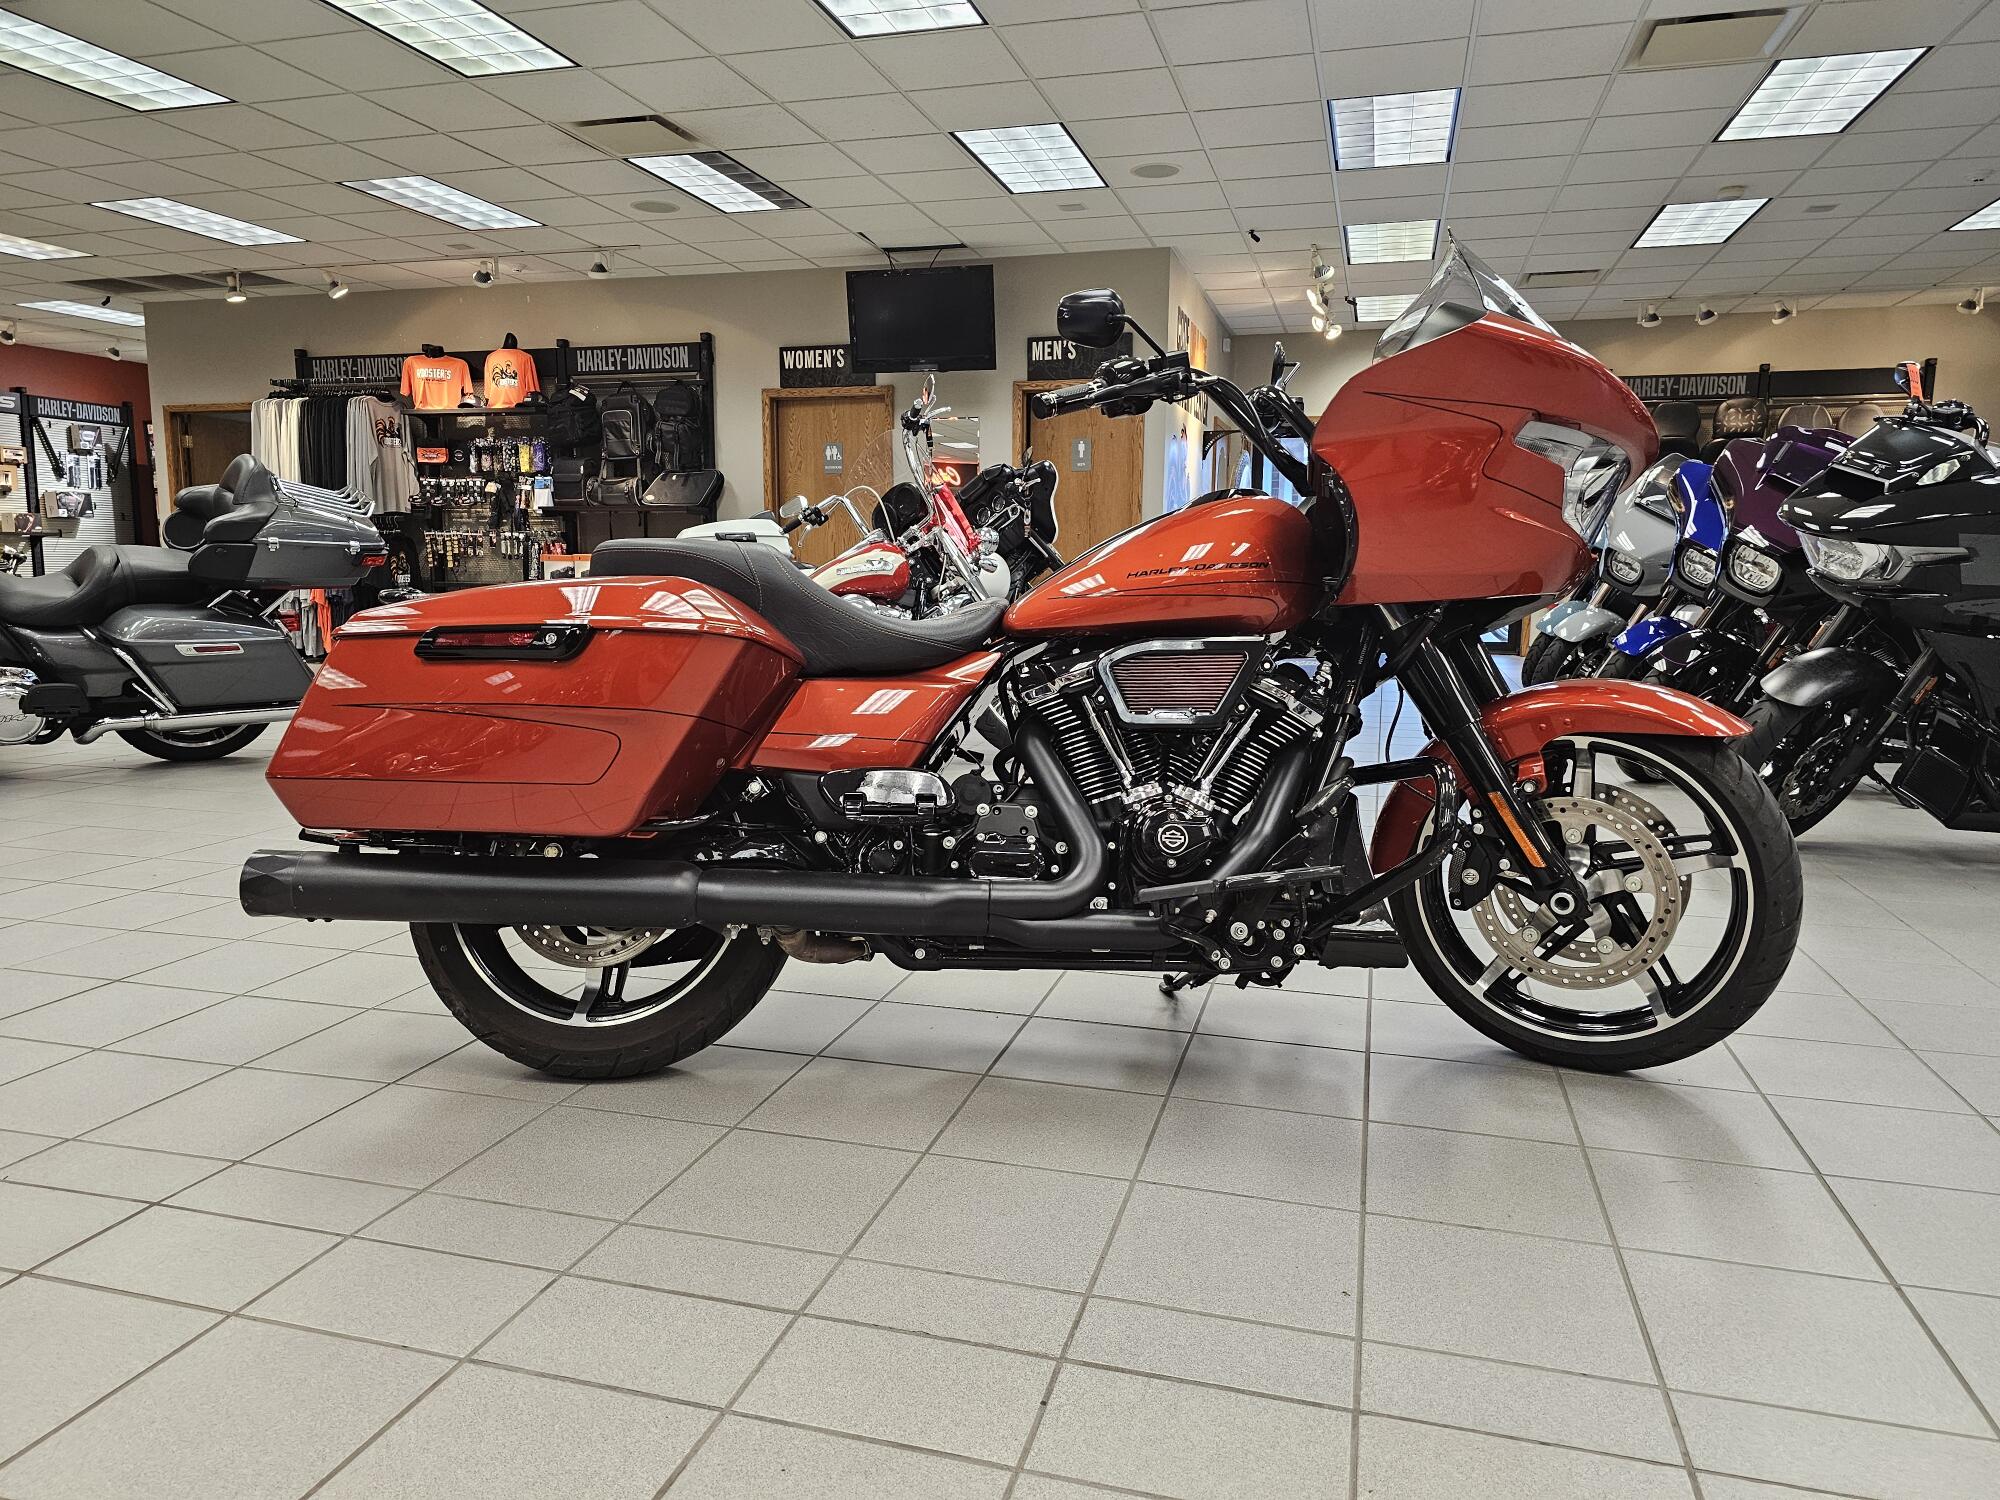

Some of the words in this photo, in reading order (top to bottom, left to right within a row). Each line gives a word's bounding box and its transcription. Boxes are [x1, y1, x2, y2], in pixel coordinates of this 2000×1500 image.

[577, 345, 689, 372] HARLEY-DAVIDSON
[782, 348, 845, 369] WOMEN'S
[1032, 340, 1077, 361] MEN'S
[312, 356, 406, 379] HARLEY-DAVIDSO
[37, 397, 121, 424] HARLEY-DAVIDSON
